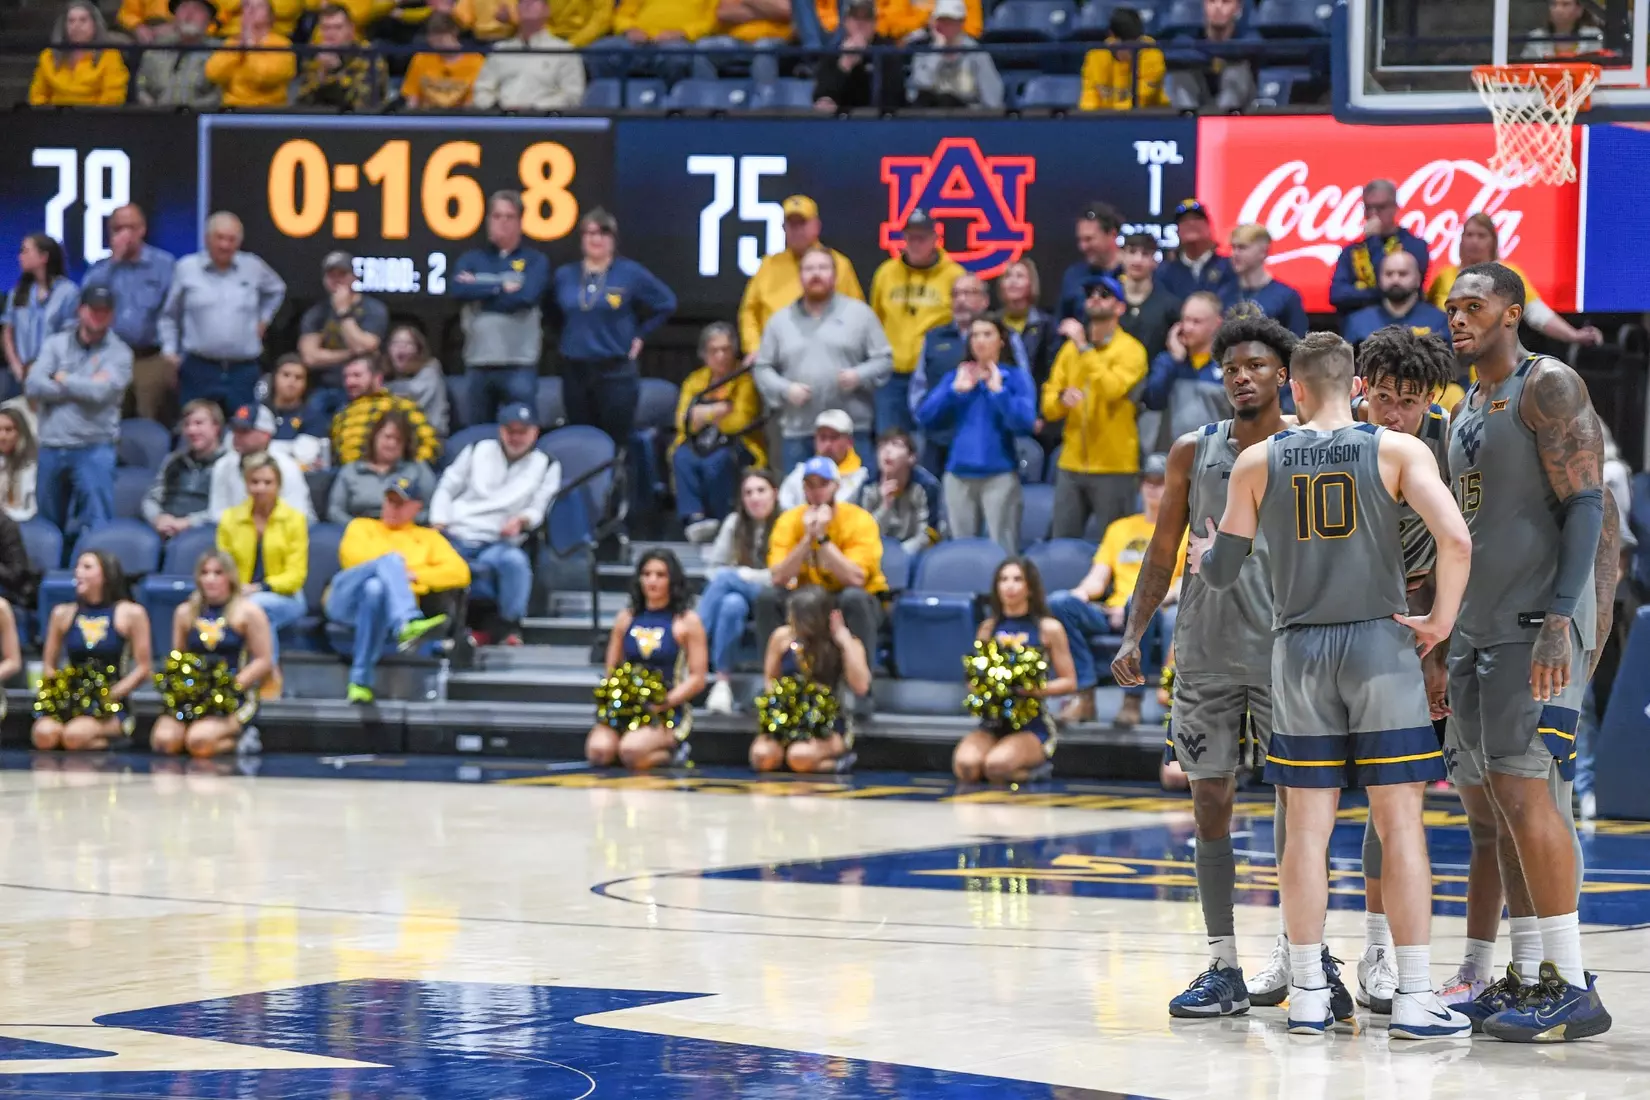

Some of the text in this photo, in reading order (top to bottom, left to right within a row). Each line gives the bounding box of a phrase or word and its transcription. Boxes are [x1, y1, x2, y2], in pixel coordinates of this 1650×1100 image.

[1133, 140, 1184, 165] TOL
[32, 148, 131, 264] 78
[1148, 163, 1162, 216] 1
[686, 155, 787, 277] 75
[427, 252, 447, 295] 2
[1283, 443, 1361, 467] STEVENSON
[1291, 471, 1357, 541] 10
[1458, 471, 1482, 514] 15
